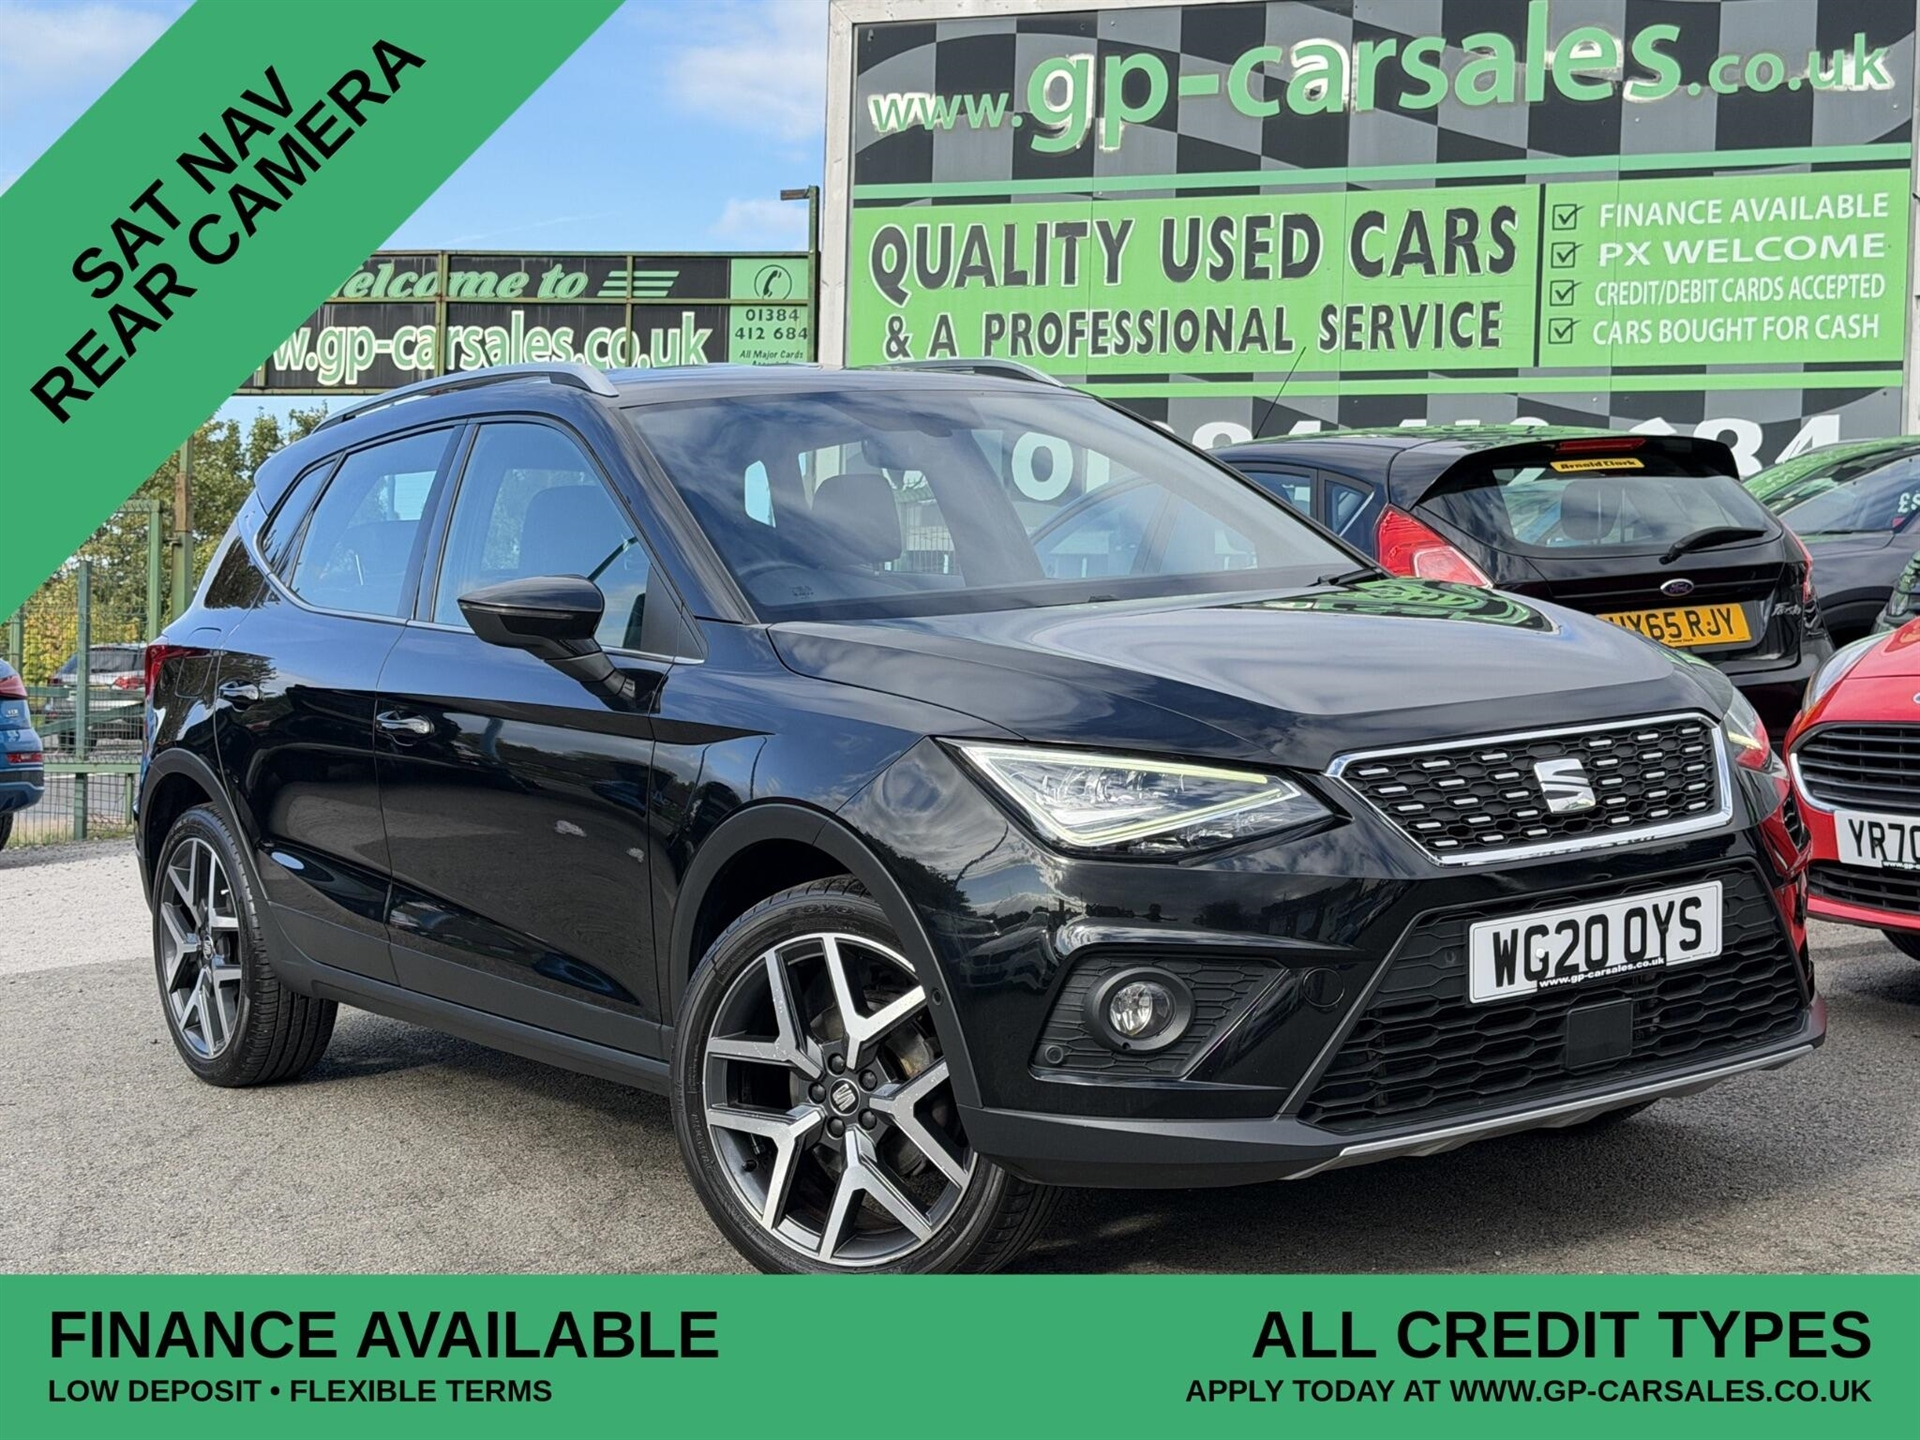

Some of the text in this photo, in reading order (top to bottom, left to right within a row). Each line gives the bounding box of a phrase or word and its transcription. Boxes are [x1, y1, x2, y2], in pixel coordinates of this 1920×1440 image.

[870, 0, 1895, 152] www.gp-carsales.co.uk
[1600, 192, 1889, 227] FINANCE AVAILABLE
[870, 205, 1518, 306] QUALITY USED CARS
[1599, 232, 1886, 267] PX WELCOME
[332, 263, 589, 299] elcome to
[1595, 273, 1886, 306] CREDIT/DEBIT CARDS ACCEPTED
[745, 308, 800, 322] 01384
[884, 301, 1503, 360] & A PROFESSIONAL SERVICE
[1593, 314, 1880, 345] CARS BOUGHT FOR CASH
[257, 309, 713, 385] w.gp-carsales.co.uk
[734, 327, 808, 340] 412 684
[740, 350, 803, 360] All Major Cards
[1608, 607, 1734, 641] X65 RJY
[1492, 914, 1610, 988] WG20
[1539, 956, 1665, 989] www.gp-carsales.co.uk
